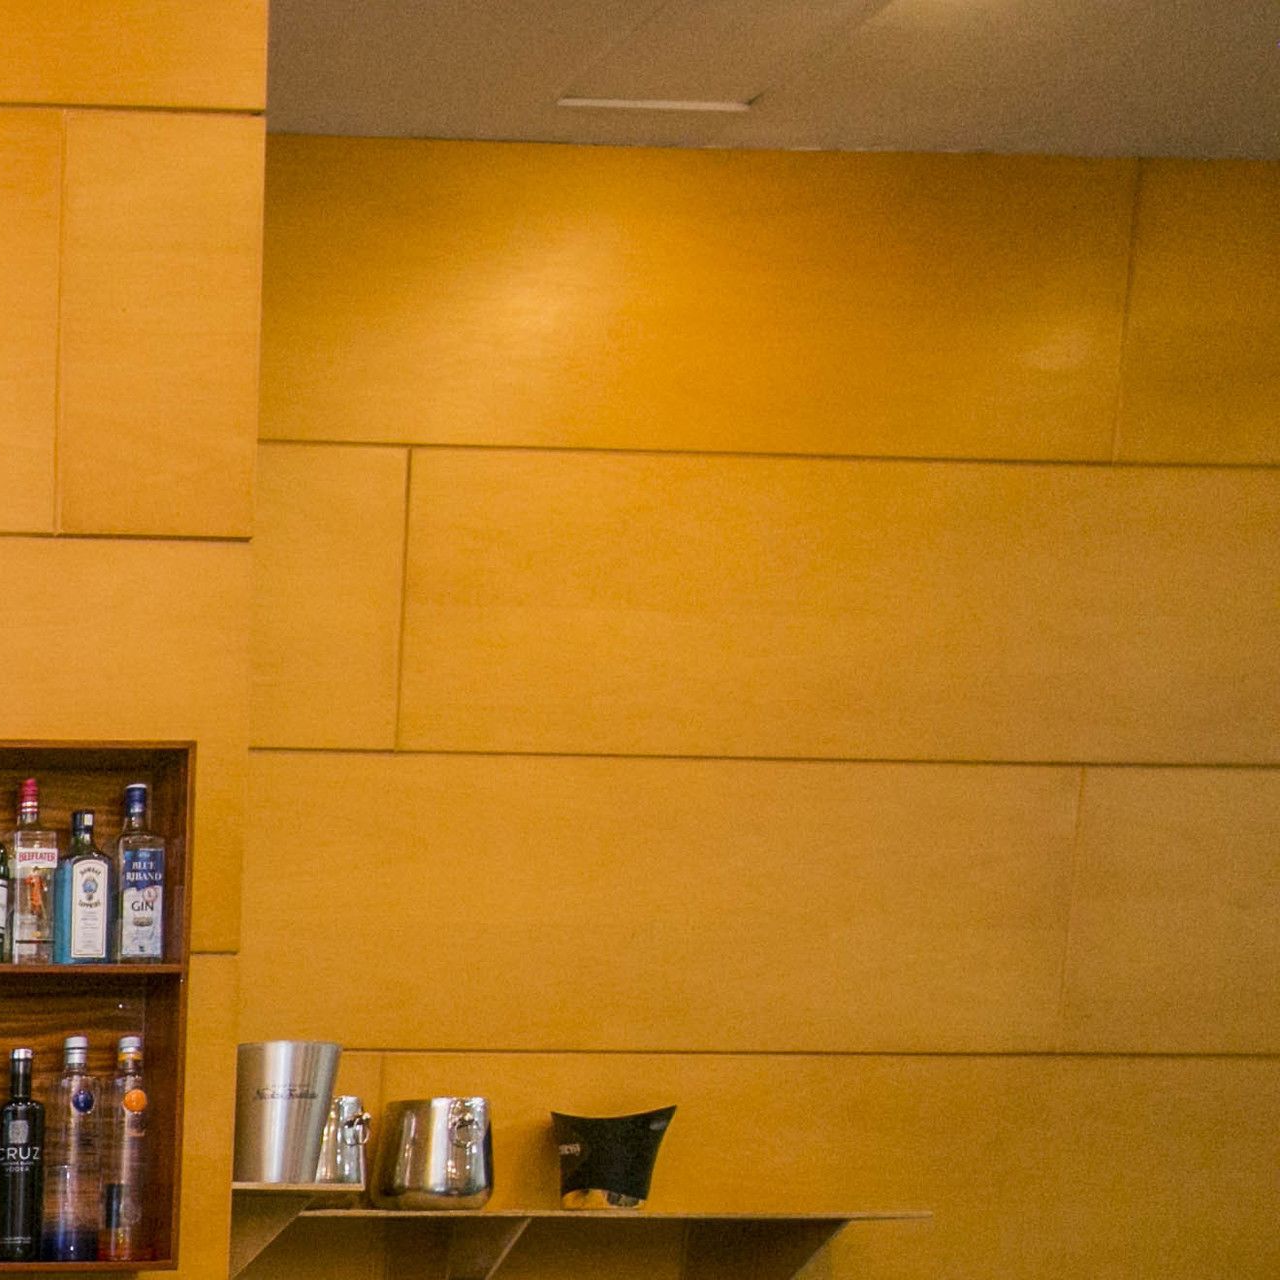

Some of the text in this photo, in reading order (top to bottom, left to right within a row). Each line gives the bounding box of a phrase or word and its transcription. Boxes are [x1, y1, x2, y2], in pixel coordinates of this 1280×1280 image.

[18, 851, 55, 862] BEEFEATER
[132, 861, 155, 870] BLUE
[131, 901, 154, 912] GIN
